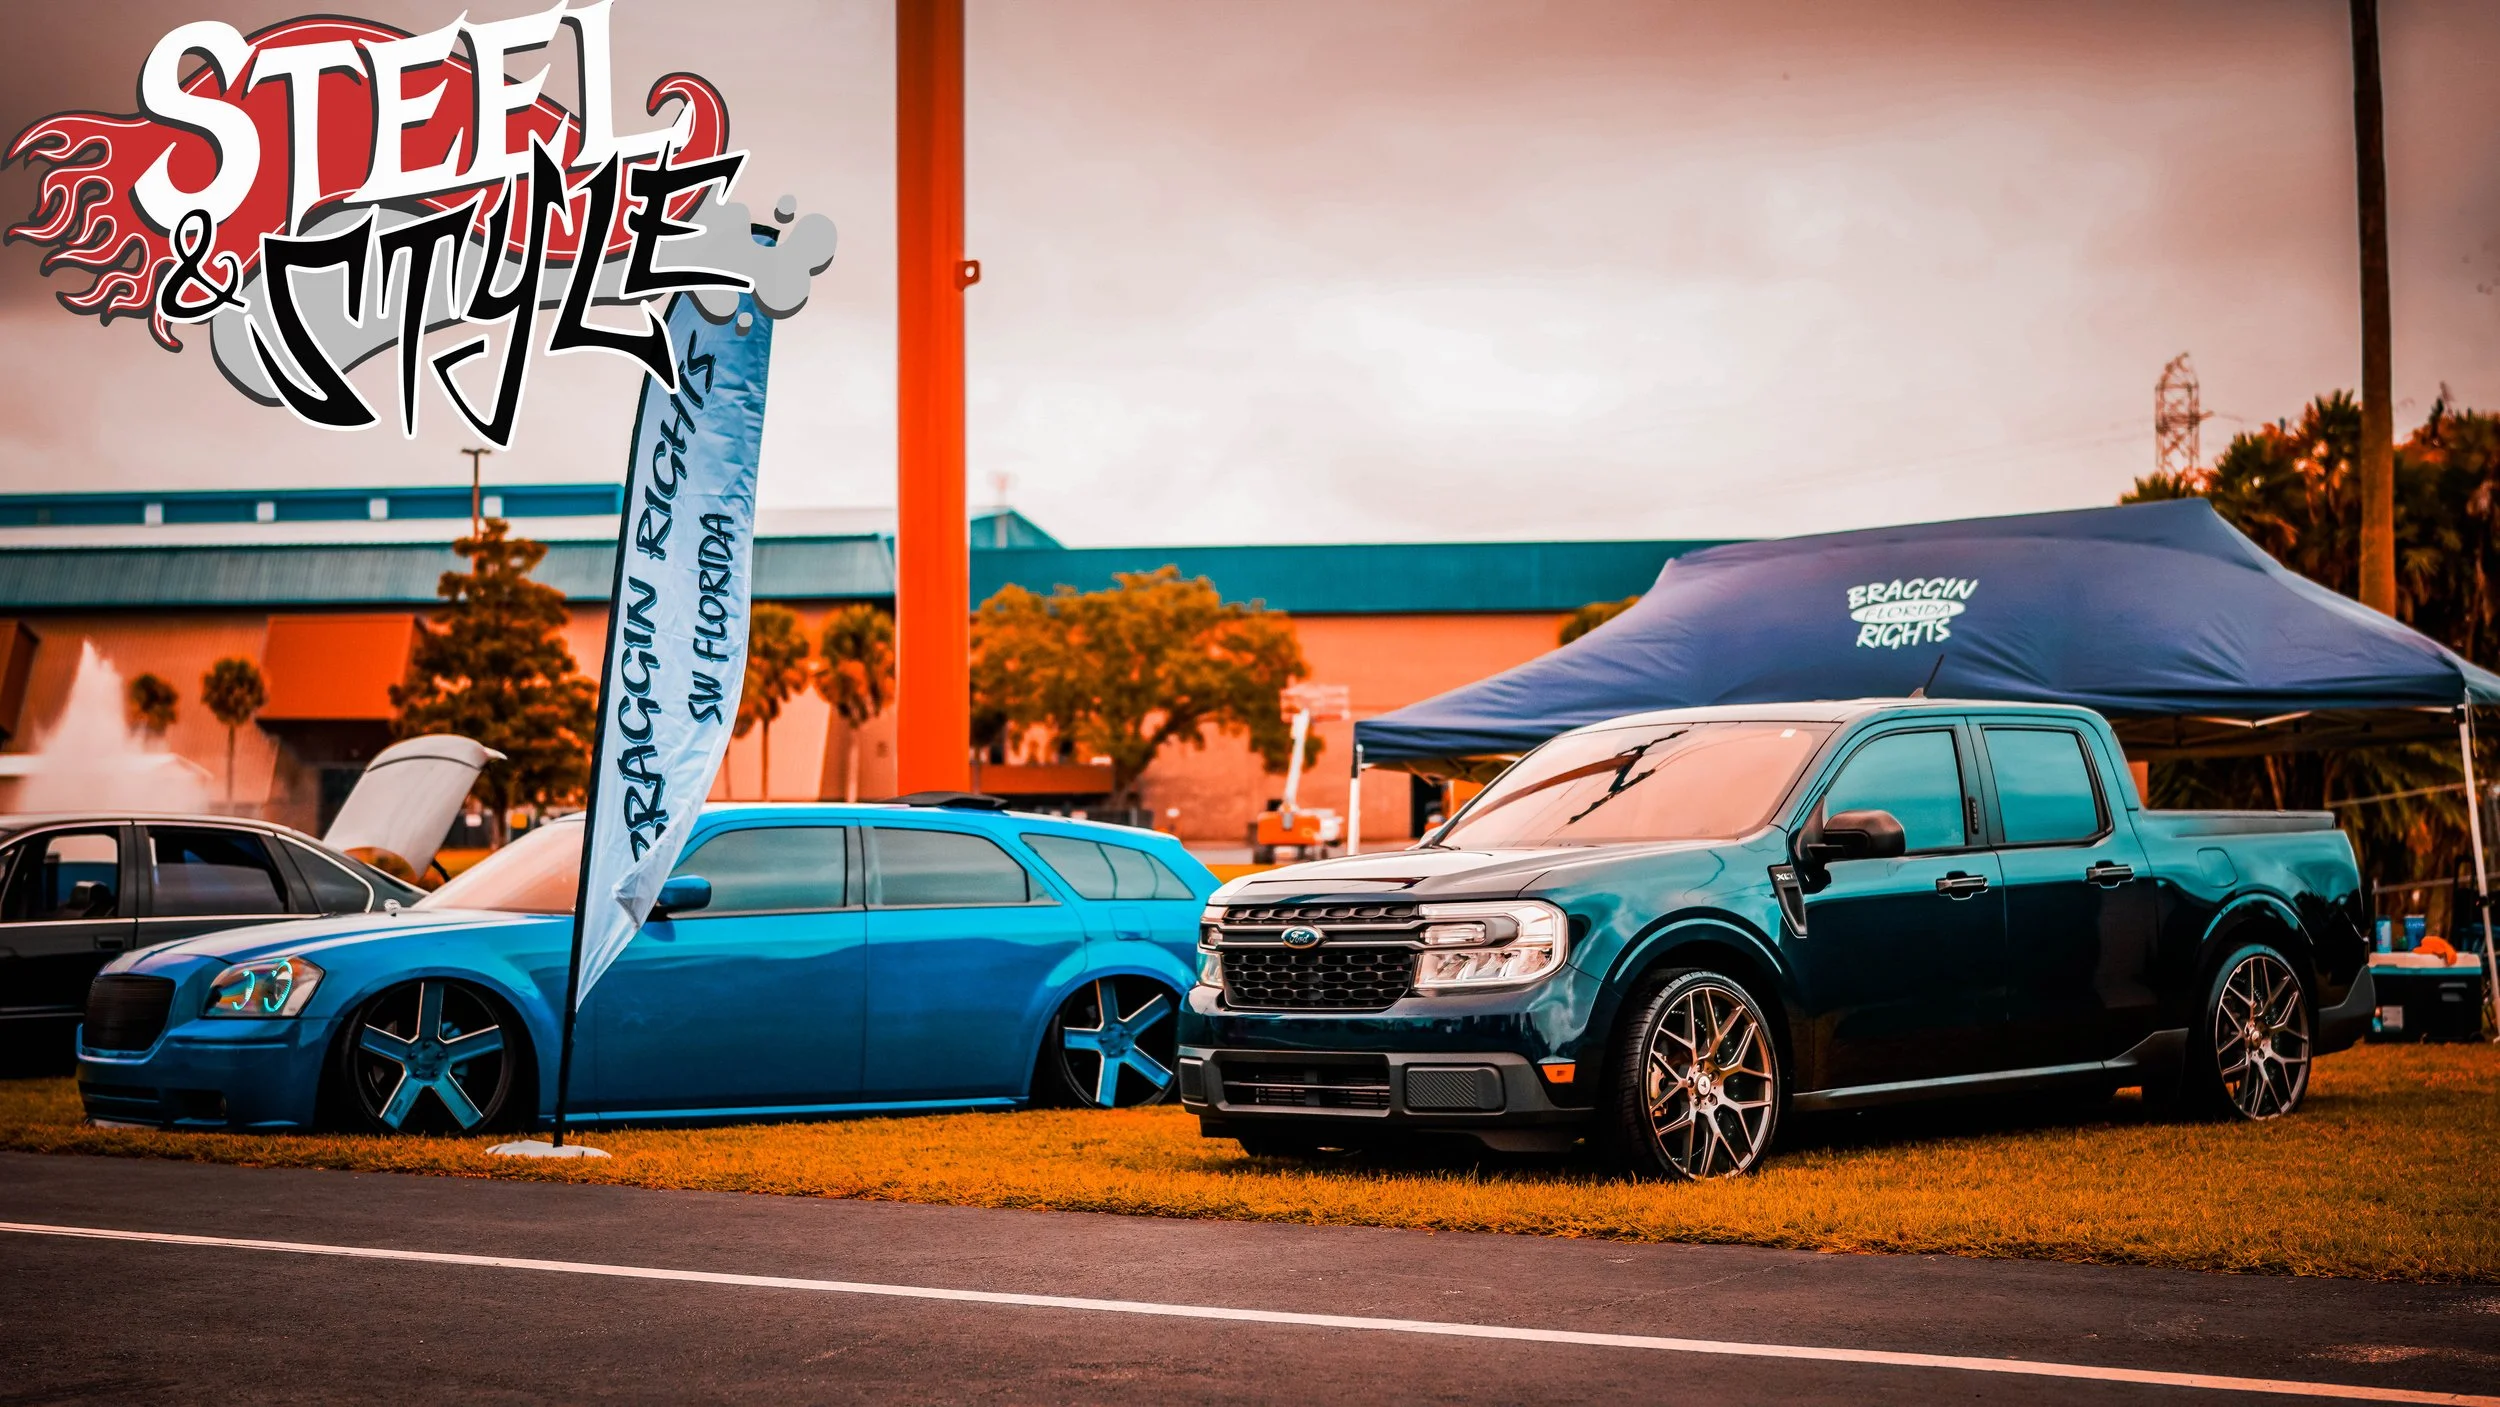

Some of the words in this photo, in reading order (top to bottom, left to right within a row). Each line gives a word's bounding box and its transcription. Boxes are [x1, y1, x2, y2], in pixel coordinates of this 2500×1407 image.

[635, 329, 717, 561] RIGHTS
[692, 512, 734, 663] FLORIDA
[1847, 577, 1979, 610] BRAGGIN
[1856, 617, 1952, 650] RIGHTS
[1864, 603, 1952, 623] FLORIDA
[688, 670, 723, 726] SW
